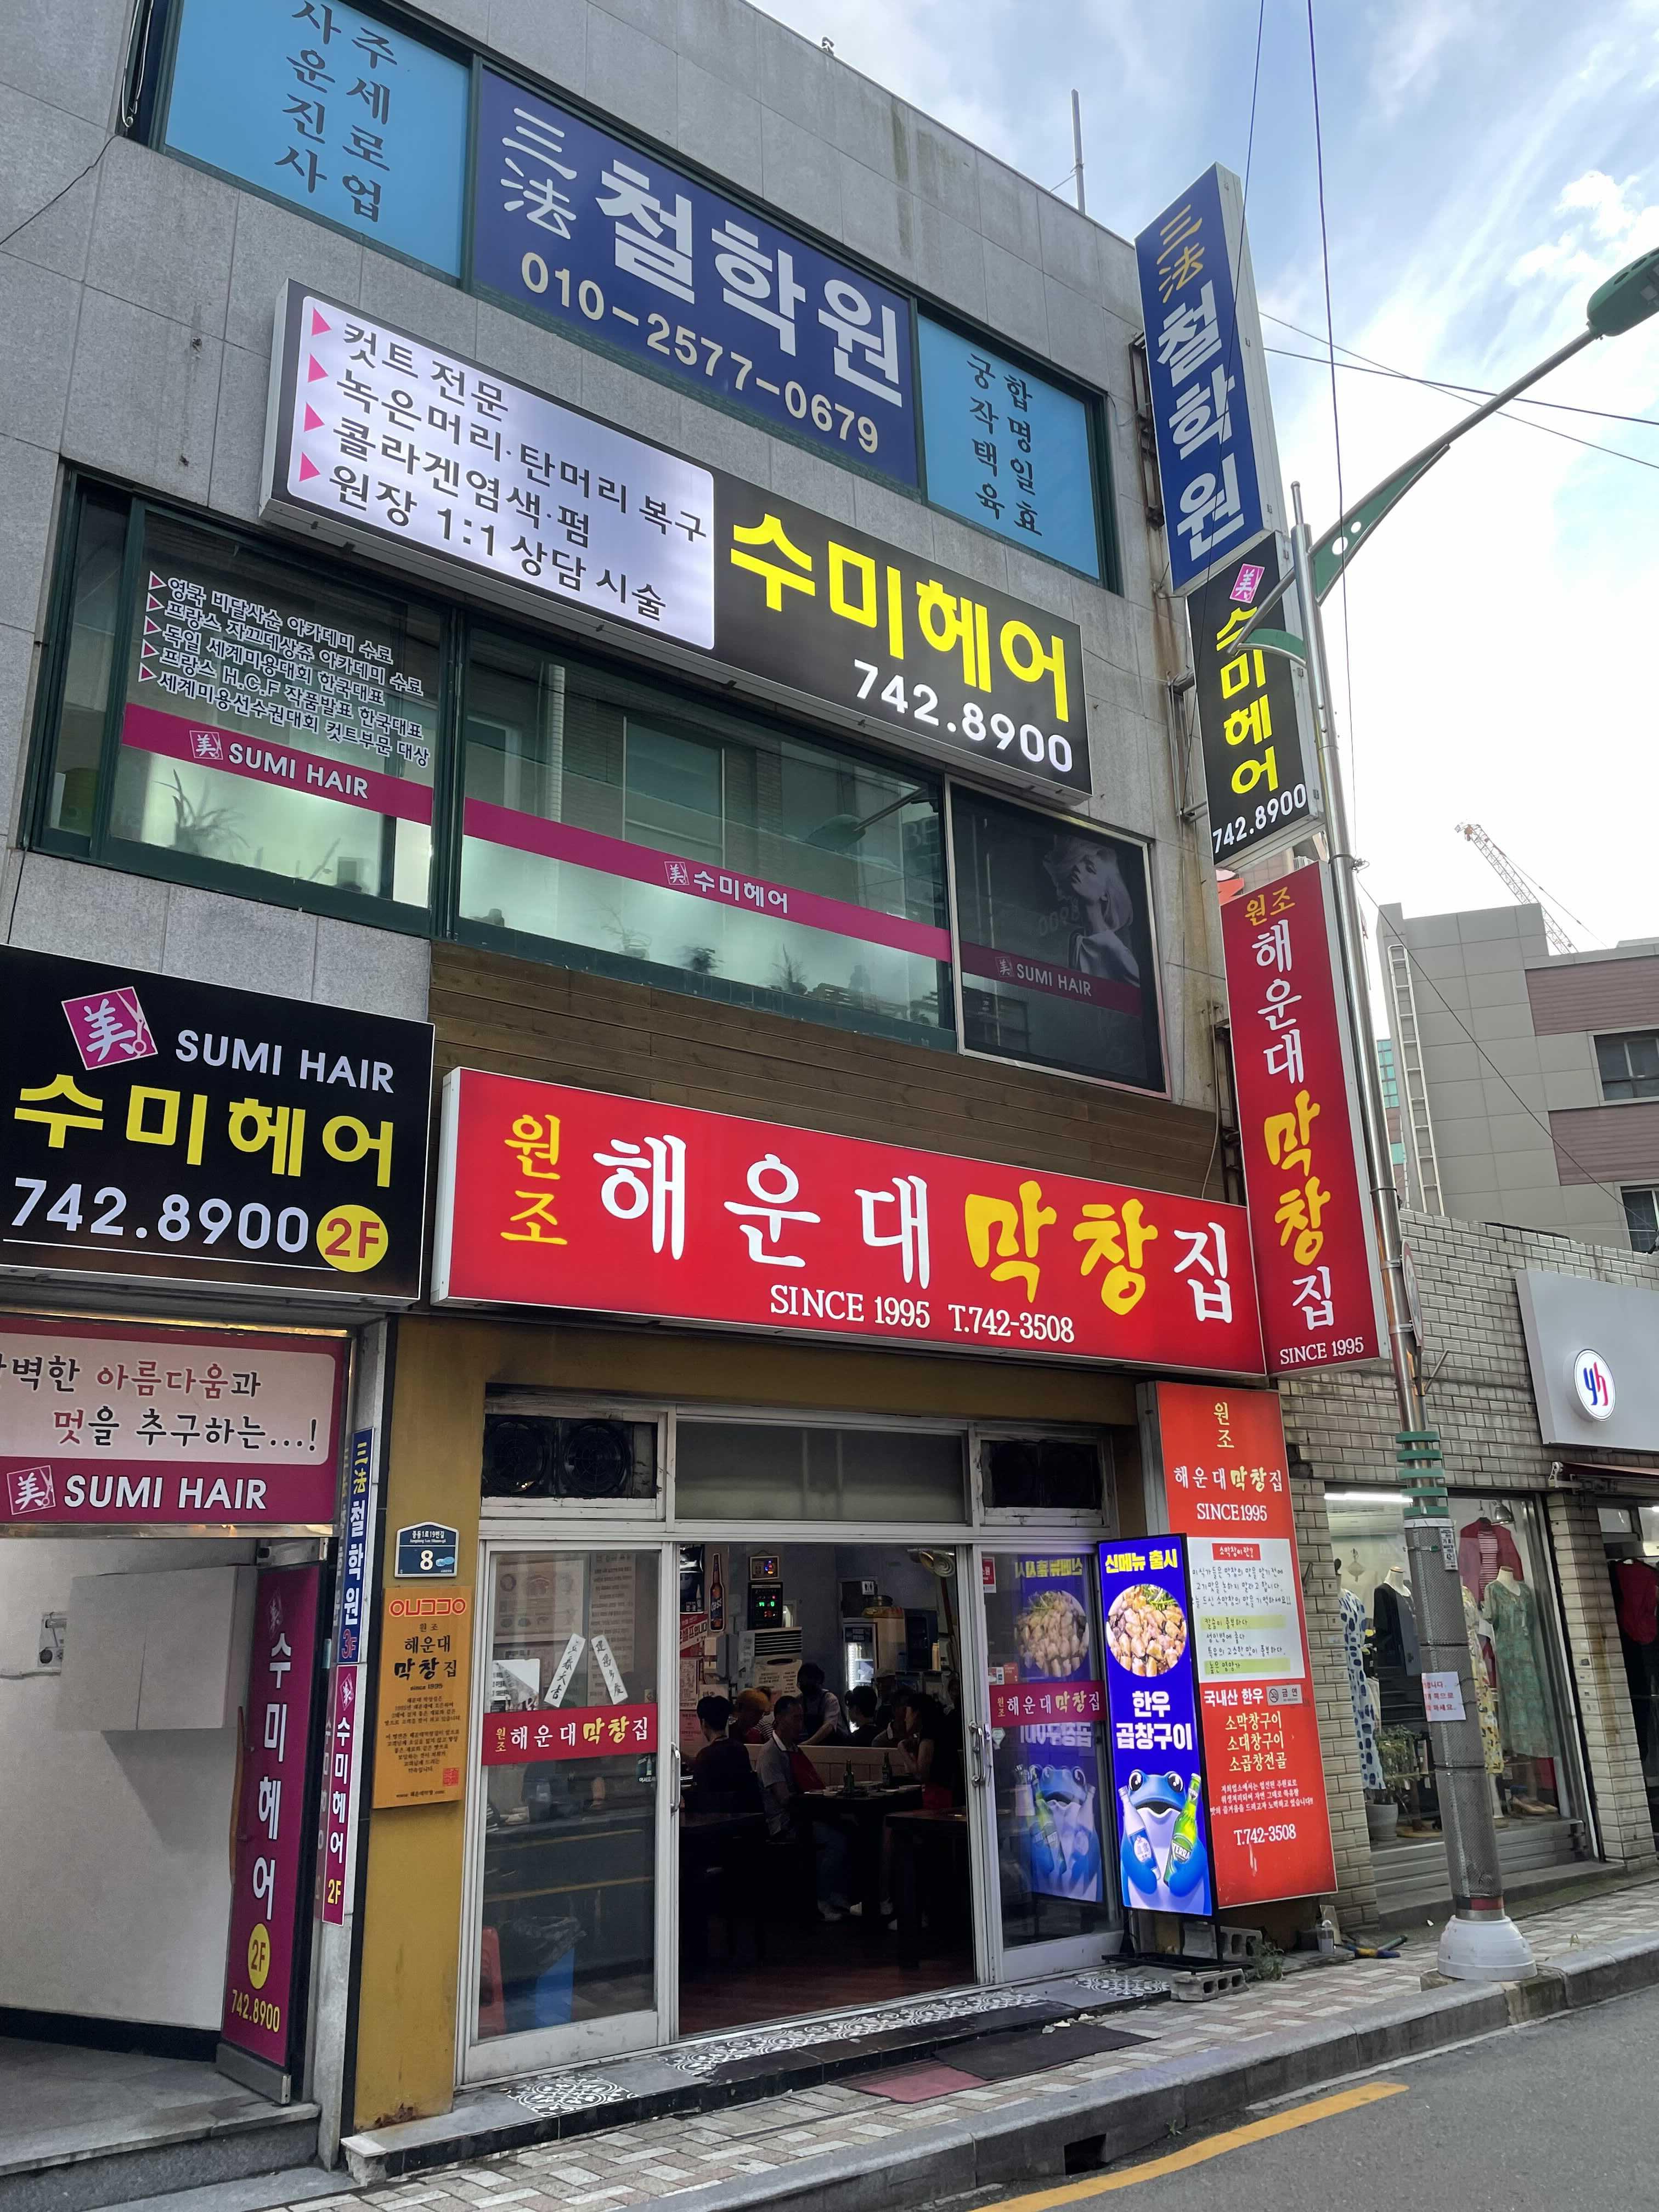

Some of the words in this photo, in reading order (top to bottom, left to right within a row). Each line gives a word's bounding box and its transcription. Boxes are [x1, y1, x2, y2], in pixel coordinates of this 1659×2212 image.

[501, 108, 577, 240] 三法
[596, 160, 902, 408] 철학원
[342, 323, 419, 379] 컷트
[431, 360, 509, 422] 전문
[521, 252, 878, 453] 010-2577-0679
[1157, 279, 1245, 561] 철학원
[639, 495, 708, 543] 복구
[329, 465, 417, 528] 원장
[595, 568, 666, 622] 시술
[167, 577, 207, 606] 영국
[211, 590, 283, 631] 비달사순
[287, 616, 354, 653] 아카데미
[359, 640, 393, 664] 수료
[730, 513, 1069, 722] 수미헤어
[163, 625, 202, 654] 독일
[207, 640, 313, 685] 세계미용대회
[319, 671, 385, 706] 한국대표
[164, 602, 222, 633] 프랑스
[319, 650, 386, 684] 아카데미
[390, 673, 424, 696] 수료
[160, 648, 217, 678] 프랑스
[223, 666, 281, 696] H.C.F
[285, 686, 353, 719] 작품발표
[359, 708, 424, 740] 한국대표
[855, 659, 1073, 772] 742.8900
[158, 671, 319, 733] 세계미용선수권대회
[325, 720, 392, 758] 컷트부문
[397, 742, 430, 768] 대상
[229, 743, 295, 779] SUMI
[307, 764, 369, 800] HAIR
[1212, 783, 1307, 854] 742.8900
[693, 871, 787, 913] 수미헤어
[1245, 886, 1296, 927] 원조
[1017, 963, 1052, 987] SUMI
[1058, 974, 1092, 997] HAIR
[175, 1029, 282, 1076] SUMI
[300, 1049, 394, 1093] HAIR
[14, 1074, 394, 1188] 수미헤어
[500, 1114, 568, 1246] 원조
[12, 1177, 308, 1253] 742.8900
[324, 1217, 381, 1259] 2F
[770, 1284, 865, 1323] SINCE
[874, 1296, 930, 1329] 1995
[949, 1304, 1075, 1344] T.742-3508
[1279, 1342, 1327, 1365] SINCE
[1331, 1336, 1364, 1357] 1995
[97, 1359, 261, 1400] 아름다움과
[54, 1404, 120, 1446] 멋을
[1213, 1402, 1234, 1448] 원조
[64, 1475, 163, 1509] SUMI
[178, 1478, 267, 1510] HAIR
[345, 1498, 365, 1626] 철학원
[420, 1550, 433, 1570] 8
[1105, 1550, 1146, 1573] 신메뉴
[1149, 1548, 1178, 1569] 출시
[342, 1628, 357, 1660] 3F
[404, 1634, 451, 1655] 해운대
[1132, 1690, 1171, 1719] 한우
[1204, 1689, 1238, 1707] 국내산
[1242, 1688, 1263, 1705] 한우
[1224, 1711, 1283, 1731] 소막창구이
[495, 1727, 506, 1752] 원조
[1115, 1722, 1193, 1752] 곱창구이
[1227, 1730, 1284, 1752] 소대창구이
[252, 1632, 292, 1920] 수미헤어
[1229, 1752, 1287, 1773] 소곱창전골
[330, 1716, 351, 1864] 수미헤어
[1172, 1842, 1190, 1859] TERRA
[1234, 1824, 1296, 1846] T.742-3508
[327, 1878, 341, 1904] 2F
[251, 1938, 267, 1972] 2F
[231, 1988, 281, 2033] 742.8900
